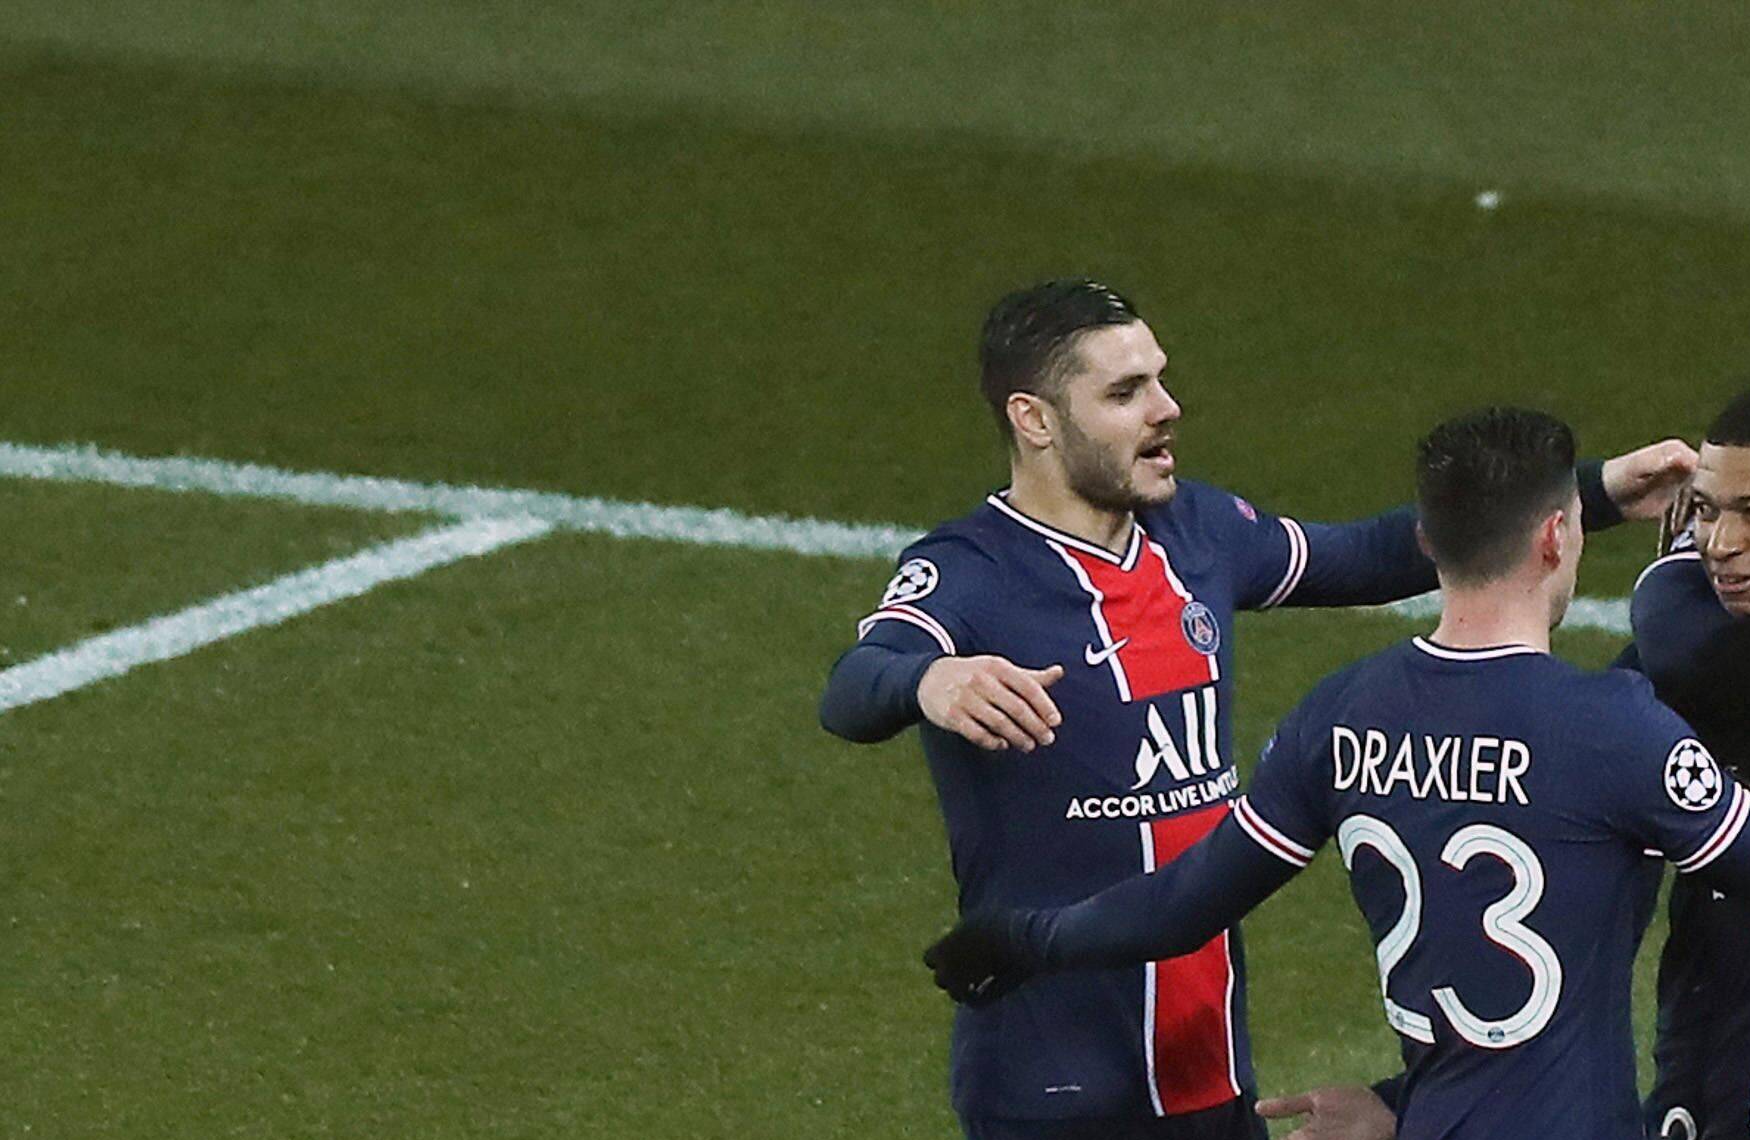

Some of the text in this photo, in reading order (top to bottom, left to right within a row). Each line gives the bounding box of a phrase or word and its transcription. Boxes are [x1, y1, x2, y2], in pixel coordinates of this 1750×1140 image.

[1066, 794, 1157, 819] ACCOR
[1158, 782, 1201, 814] LIVE
[1332, 726, 1531, 806] DRAXLER
[1337, 813, 1563, 1050] 23
